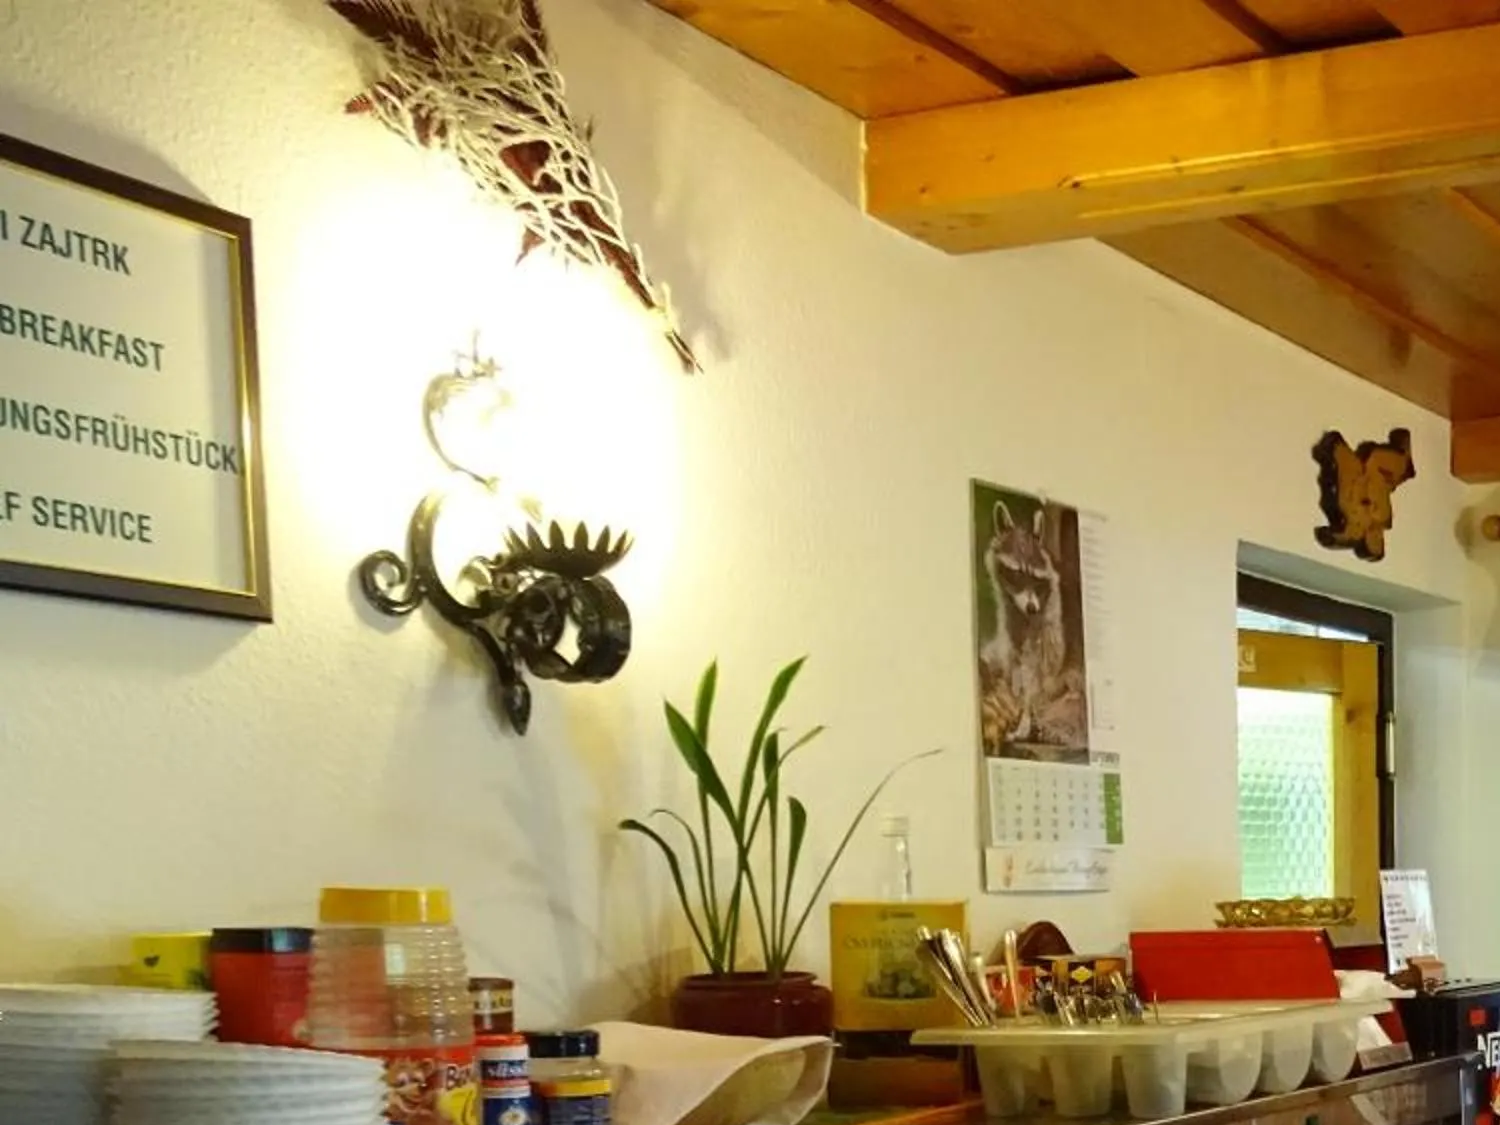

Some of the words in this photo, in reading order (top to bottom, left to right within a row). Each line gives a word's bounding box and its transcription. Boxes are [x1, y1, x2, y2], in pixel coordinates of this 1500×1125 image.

[19, 214, 131, 276] ZAJTRK
[0, 303, 166, 373] BREAKFAST
[32, 496, 153, 543] SERVICE
